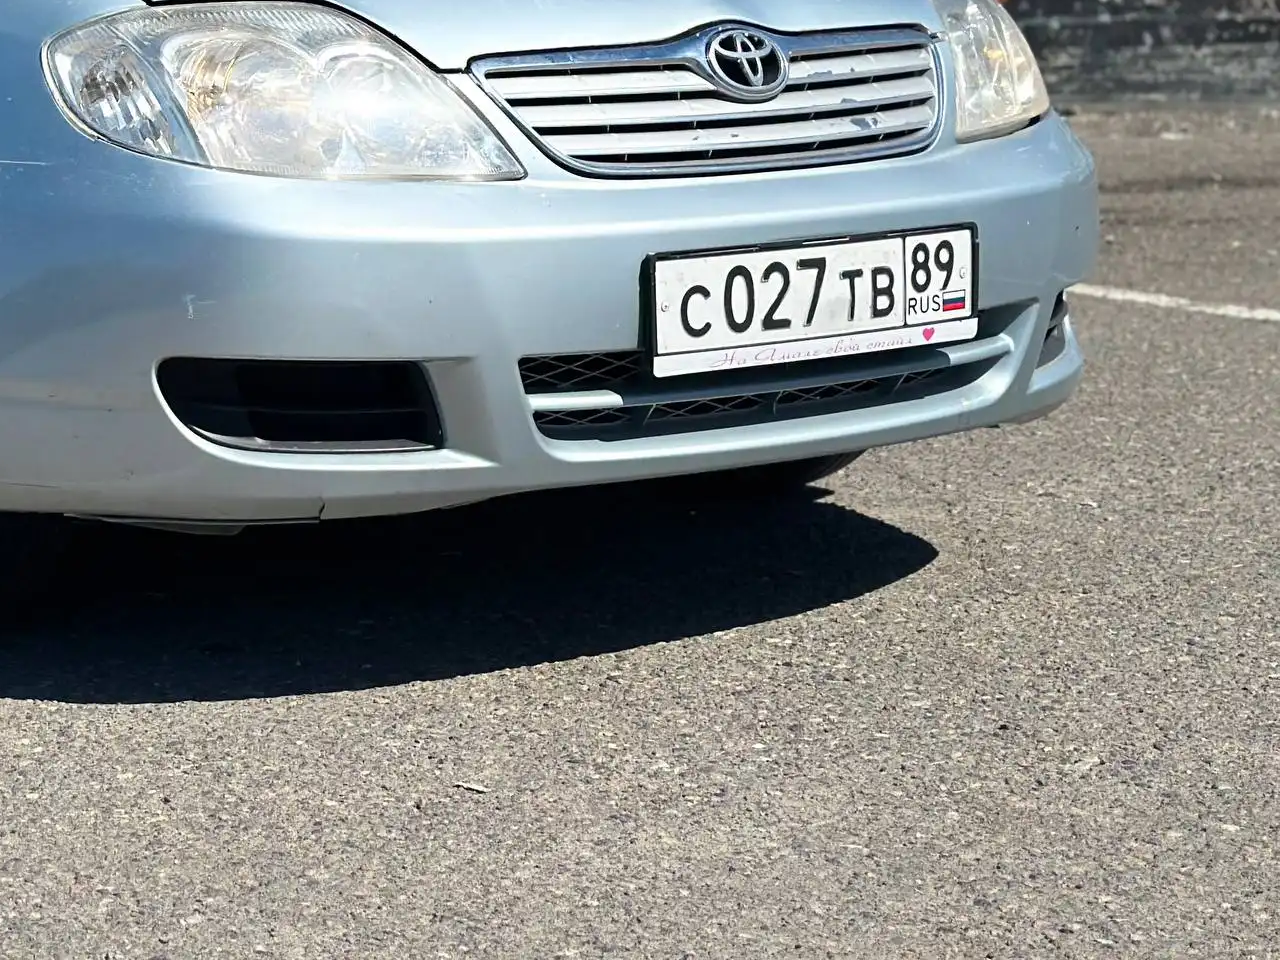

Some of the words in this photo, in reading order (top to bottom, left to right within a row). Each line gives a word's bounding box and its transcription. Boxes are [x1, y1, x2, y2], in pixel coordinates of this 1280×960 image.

[910, 240, 955, 293] 89
[907, 294, 941, 316] RUS
[710, 350, 747, 368] На
[826, 337, 860, 355] свой
